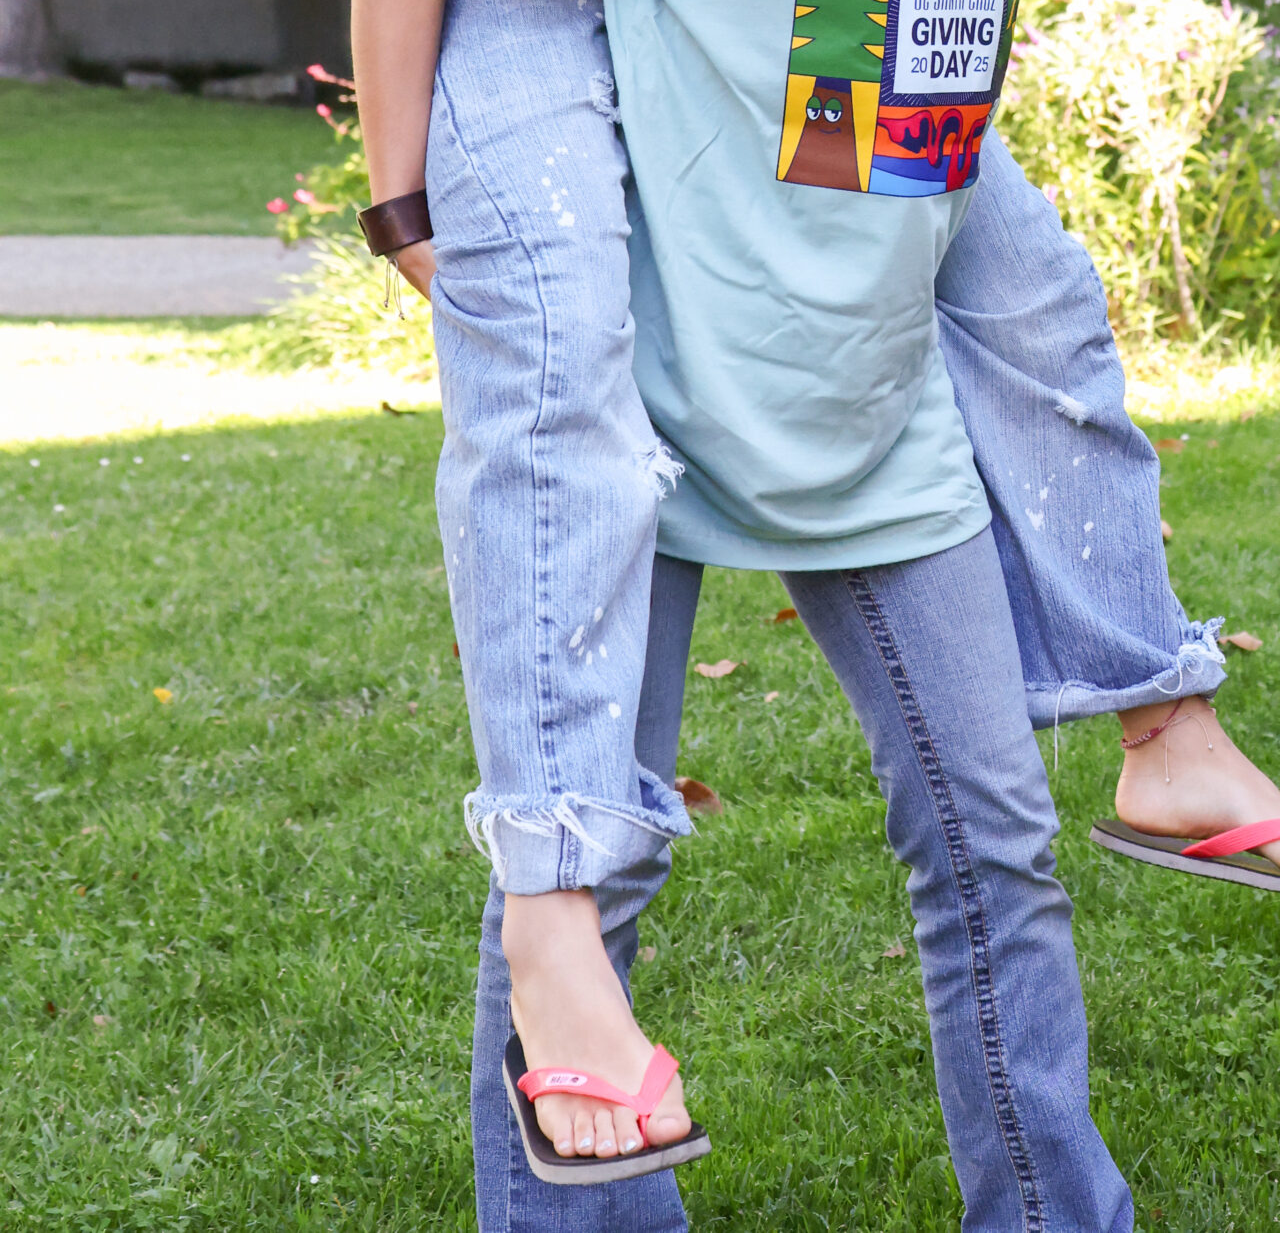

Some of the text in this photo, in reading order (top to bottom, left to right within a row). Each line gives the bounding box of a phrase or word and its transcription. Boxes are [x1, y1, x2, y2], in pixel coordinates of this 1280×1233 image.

[911, 17, 995, 47] GIVING
[910, 49, 989, 79] 20 DAY 25
